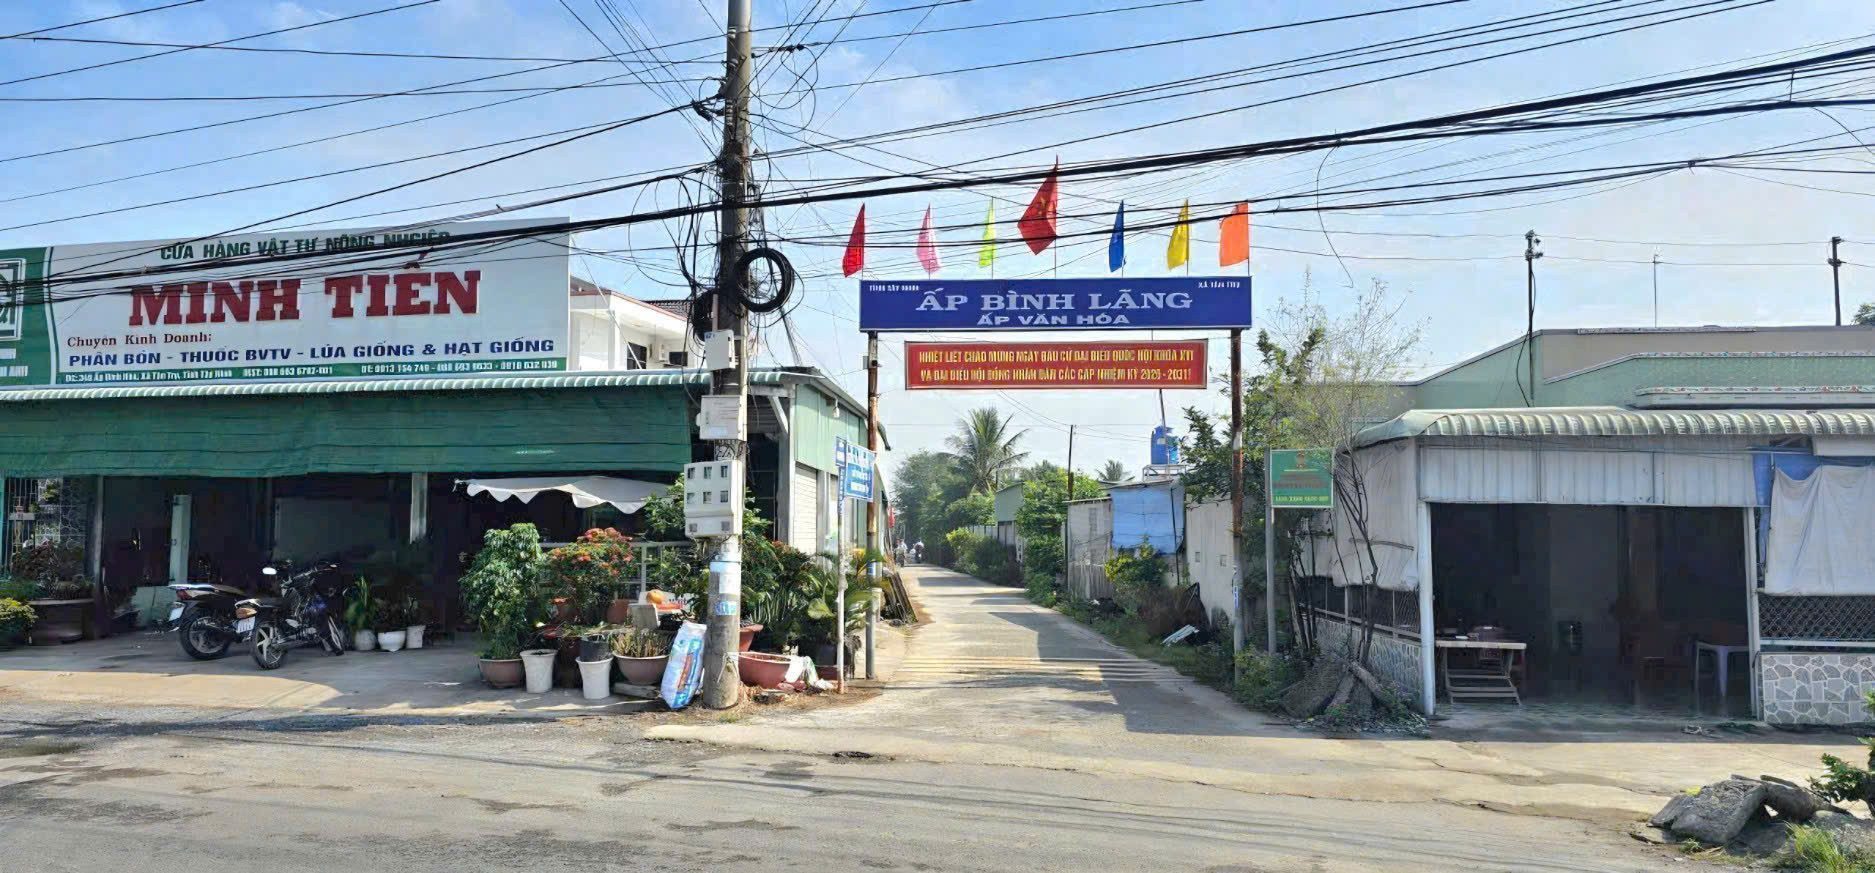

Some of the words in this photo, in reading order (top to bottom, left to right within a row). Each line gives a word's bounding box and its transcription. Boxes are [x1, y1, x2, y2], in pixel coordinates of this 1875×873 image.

[203, 240, 250, 259] HÀNG
[129, 278, 301, 326] MINH
[324, 247, 481, 319] TIẾN
[915, 287, 969, 311] ẤP
[981, 289, 1075, 311] BÌNH
[1088, 288, 1193, 310] LÃNG
[1017, 313, 1068, 325] VĂN
[1076, 311, 1131, 325] HÓA
[67, 334, 117, 350] Chuyên
[125, 333, 157, 346] Kinh
[163, 331, 213, 345] Doanh:
[69, 350, 118, 367] PHÂN
[123, 348, 161, 365] BÓN
[180, 345, 239, 362] THUỐC
[245, 348, 291, 361] BVTV
[310, 342, 346, 359] LÚA
[353, 338, 415, 357] GIỐNG
[422, 343, 436, 355] &
[444, 342, 482, 357] HẠT
[490, 336, 554, 354] GIỐNG
[1137, 349, 1153, 363] HỘI
[1058, 367, 1076, 380] CÁC
